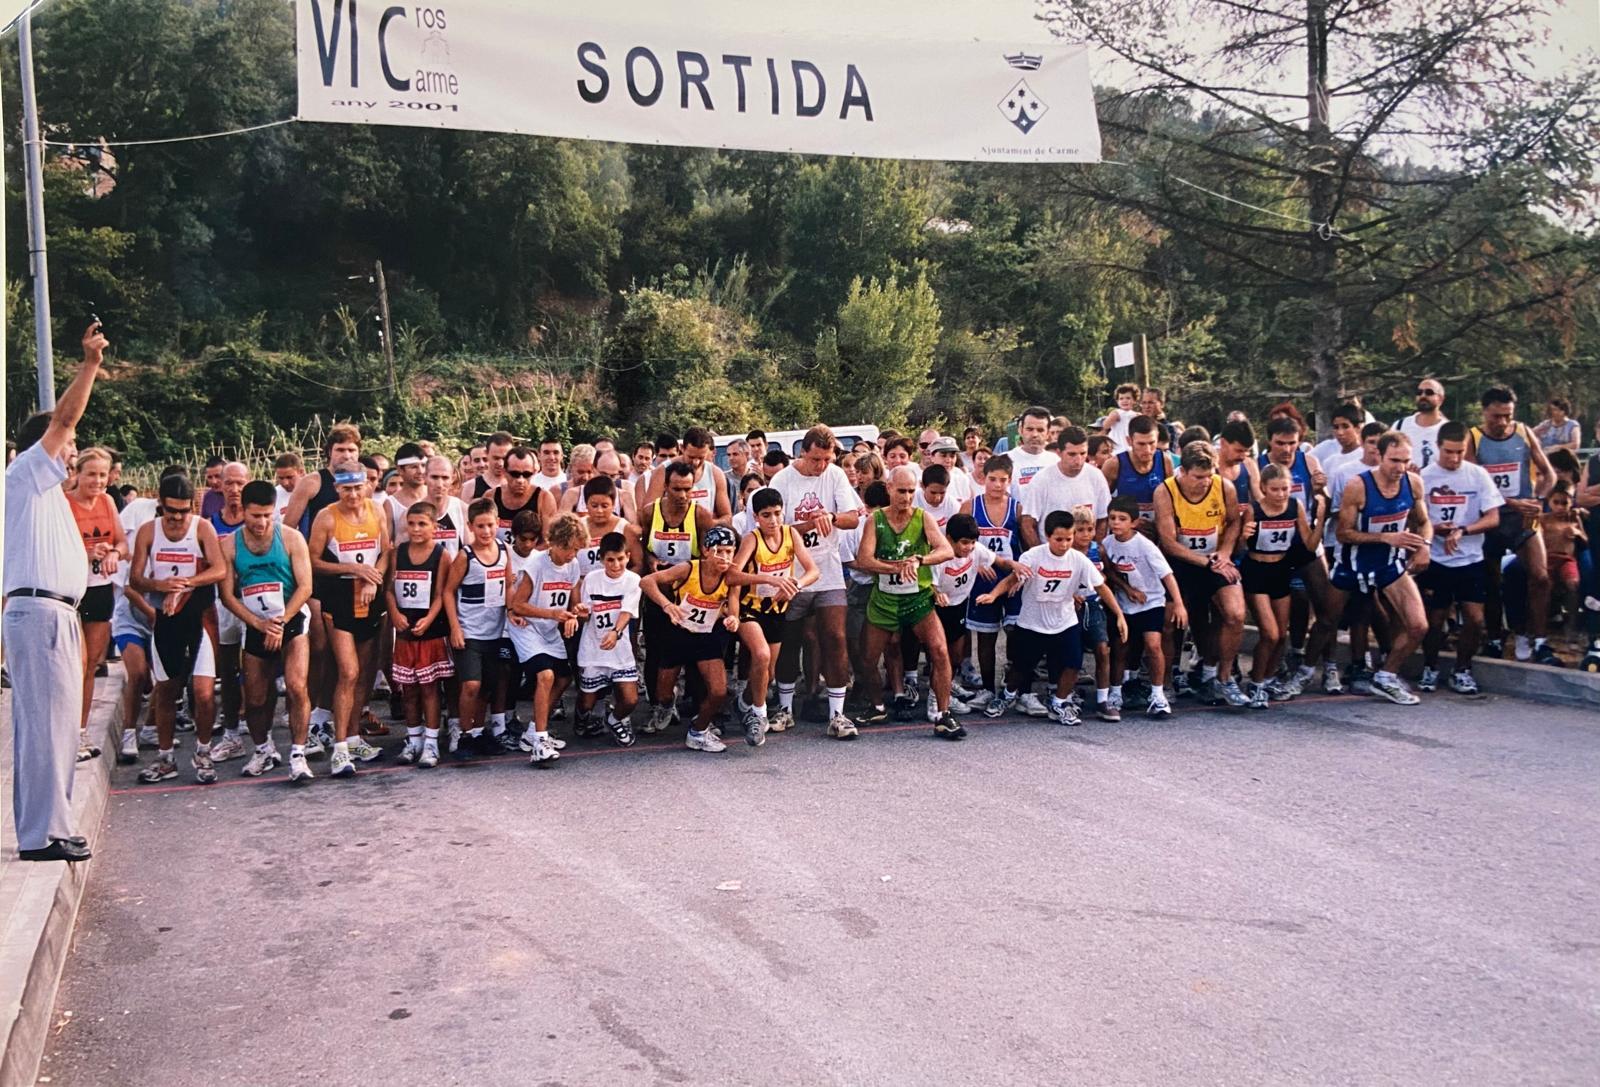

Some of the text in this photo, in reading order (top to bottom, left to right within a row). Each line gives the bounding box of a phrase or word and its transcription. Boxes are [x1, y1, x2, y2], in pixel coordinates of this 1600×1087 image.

[311, 0, 360, 88] VI
[576, 41, 874, 122] SORTIDA
[331, 100, 459, 112] any 2001
[981, 146, 1080, 155] Ajuntament de Carme
[1493, 474, 1510, 489] 93
[1440, 507, 1456, 521] 37
[802, 532, 819, 548] 82
[988, 537, 1003, 552] 42
[1189, 537, 1207, 550] 13
[1270, 531, 1288, 544] 34
[667, 542, 676, 556] 5
[954, 573, 968, 588] 30
[1043, 580, 1061, 592] 57
[402, 582, 418, 598] 58
[257, 596, 269, 611] 1
[549, 591, 566, 607] 10
[596, 612, 613, 629] 31
[688, 608, 706, 624] 21
